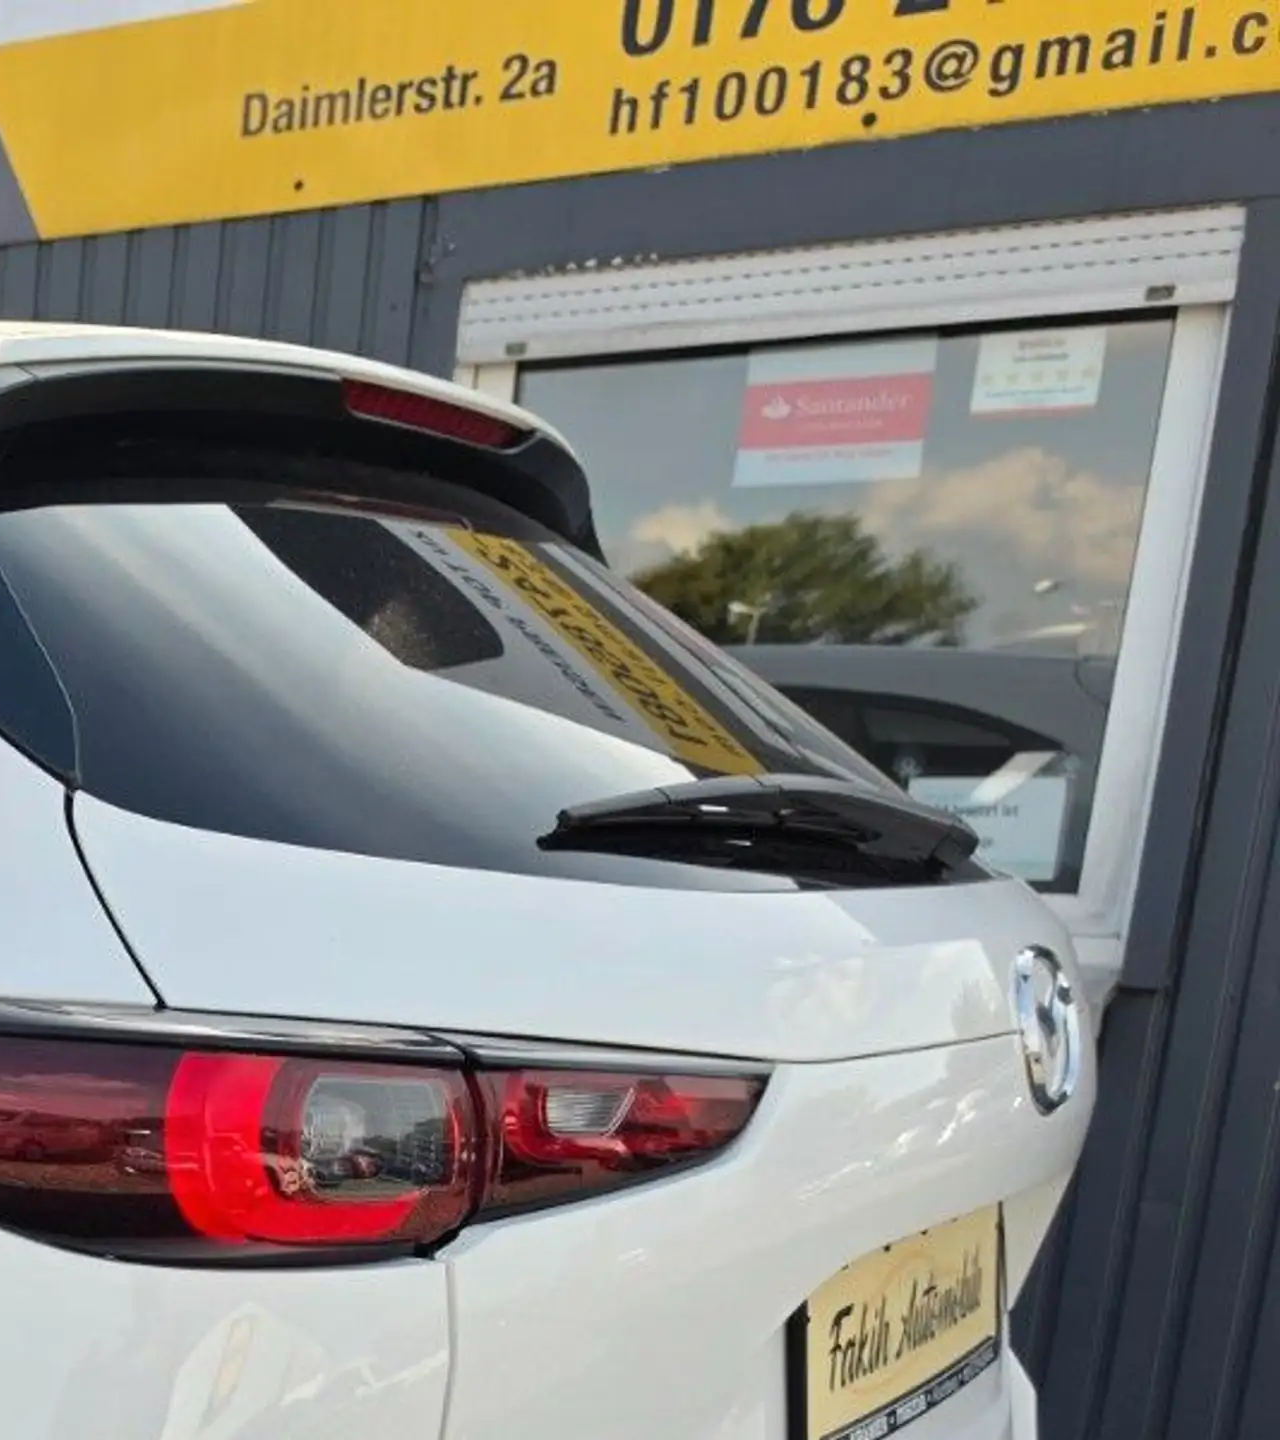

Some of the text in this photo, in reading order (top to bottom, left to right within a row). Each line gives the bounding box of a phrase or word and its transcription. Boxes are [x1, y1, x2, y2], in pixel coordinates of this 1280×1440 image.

[241, 52, 558, 138] Daimlerstr. 2a
[608, 7, 1280, 136] hf100183@gmail.c
[828, 1292, 890, 1394] Fakih
